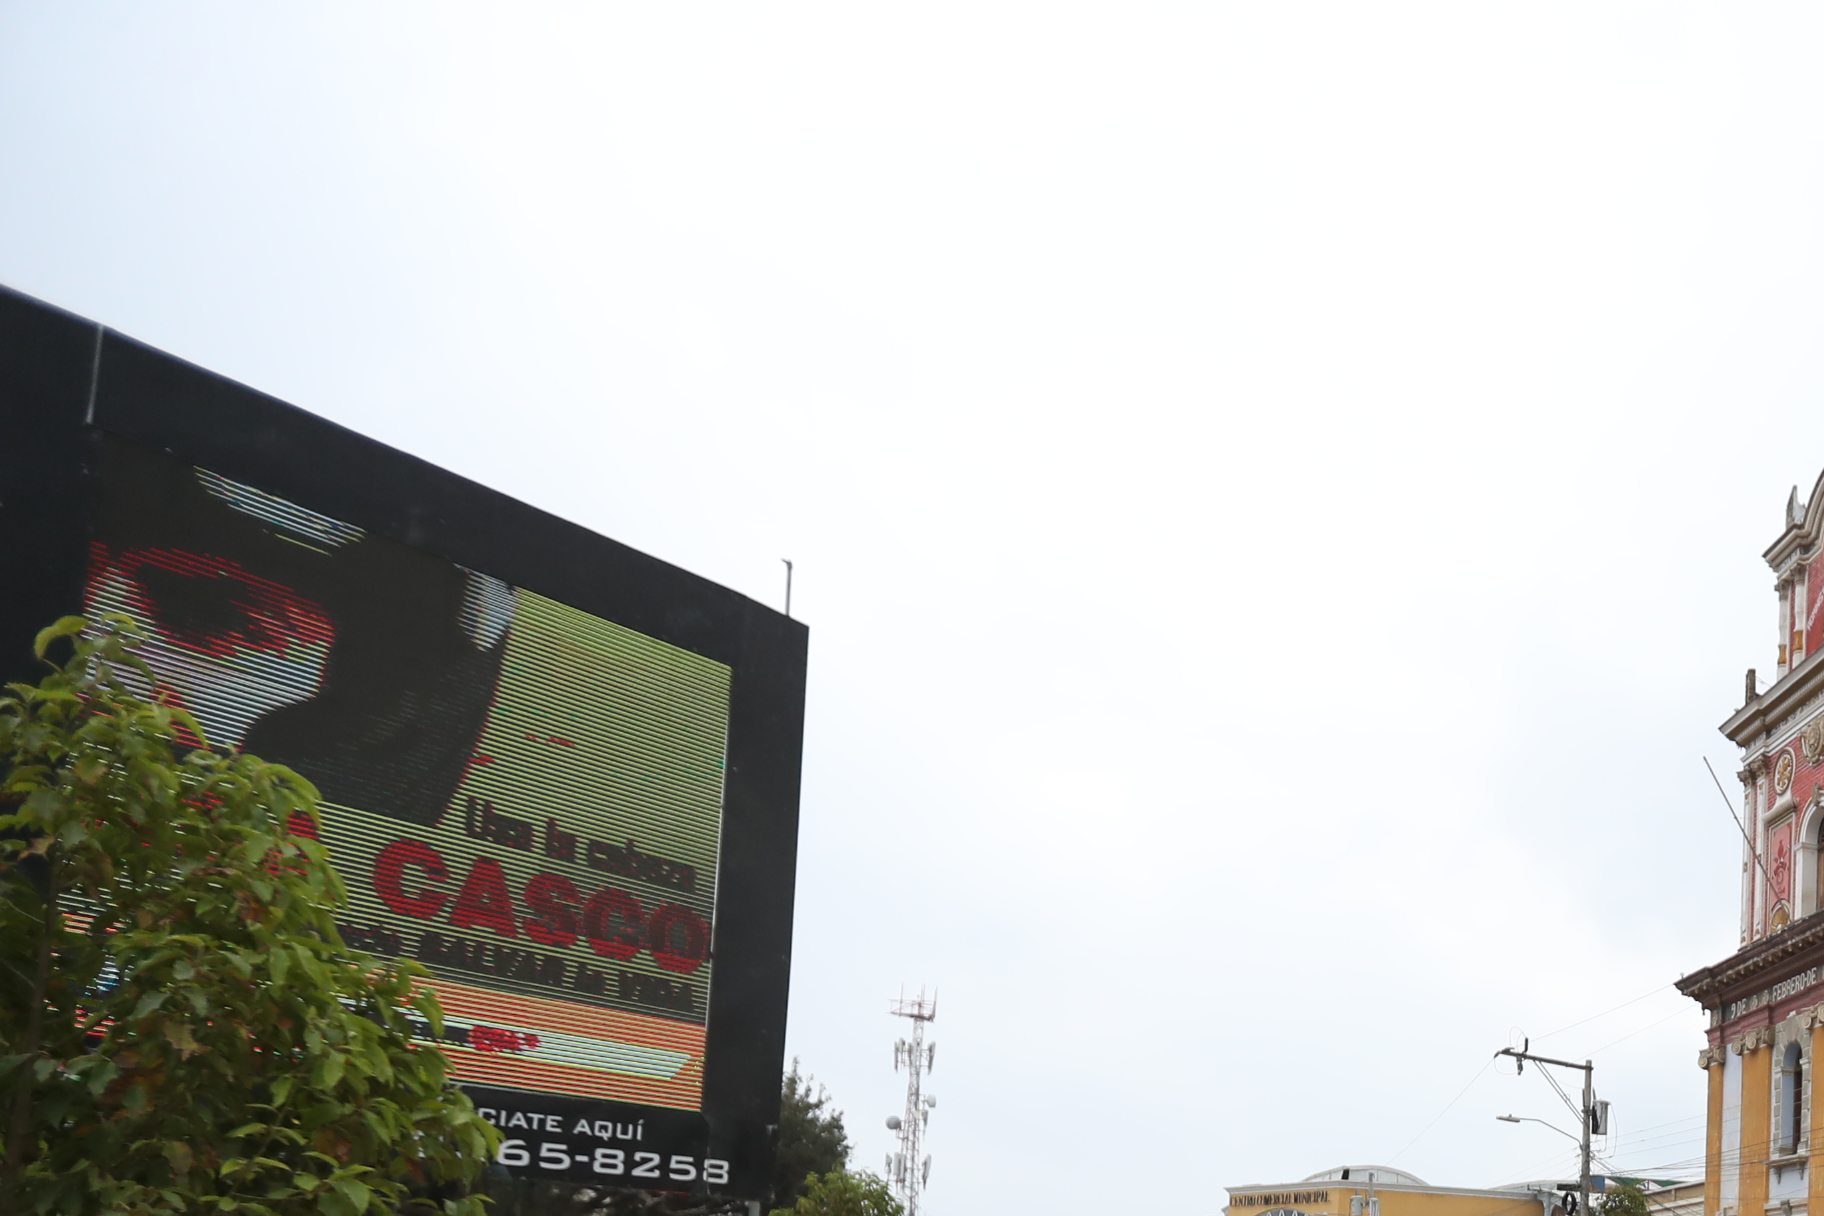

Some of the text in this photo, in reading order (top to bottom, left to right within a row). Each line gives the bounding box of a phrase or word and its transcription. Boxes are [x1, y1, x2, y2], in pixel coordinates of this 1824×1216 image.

[373, 838, 711, 973] CASCO
[1730, 1003, 1736, 1019] 9
[1737, 998, 1747, 1016] DE
[573, 1119, 645, 1141] AQUÍ
